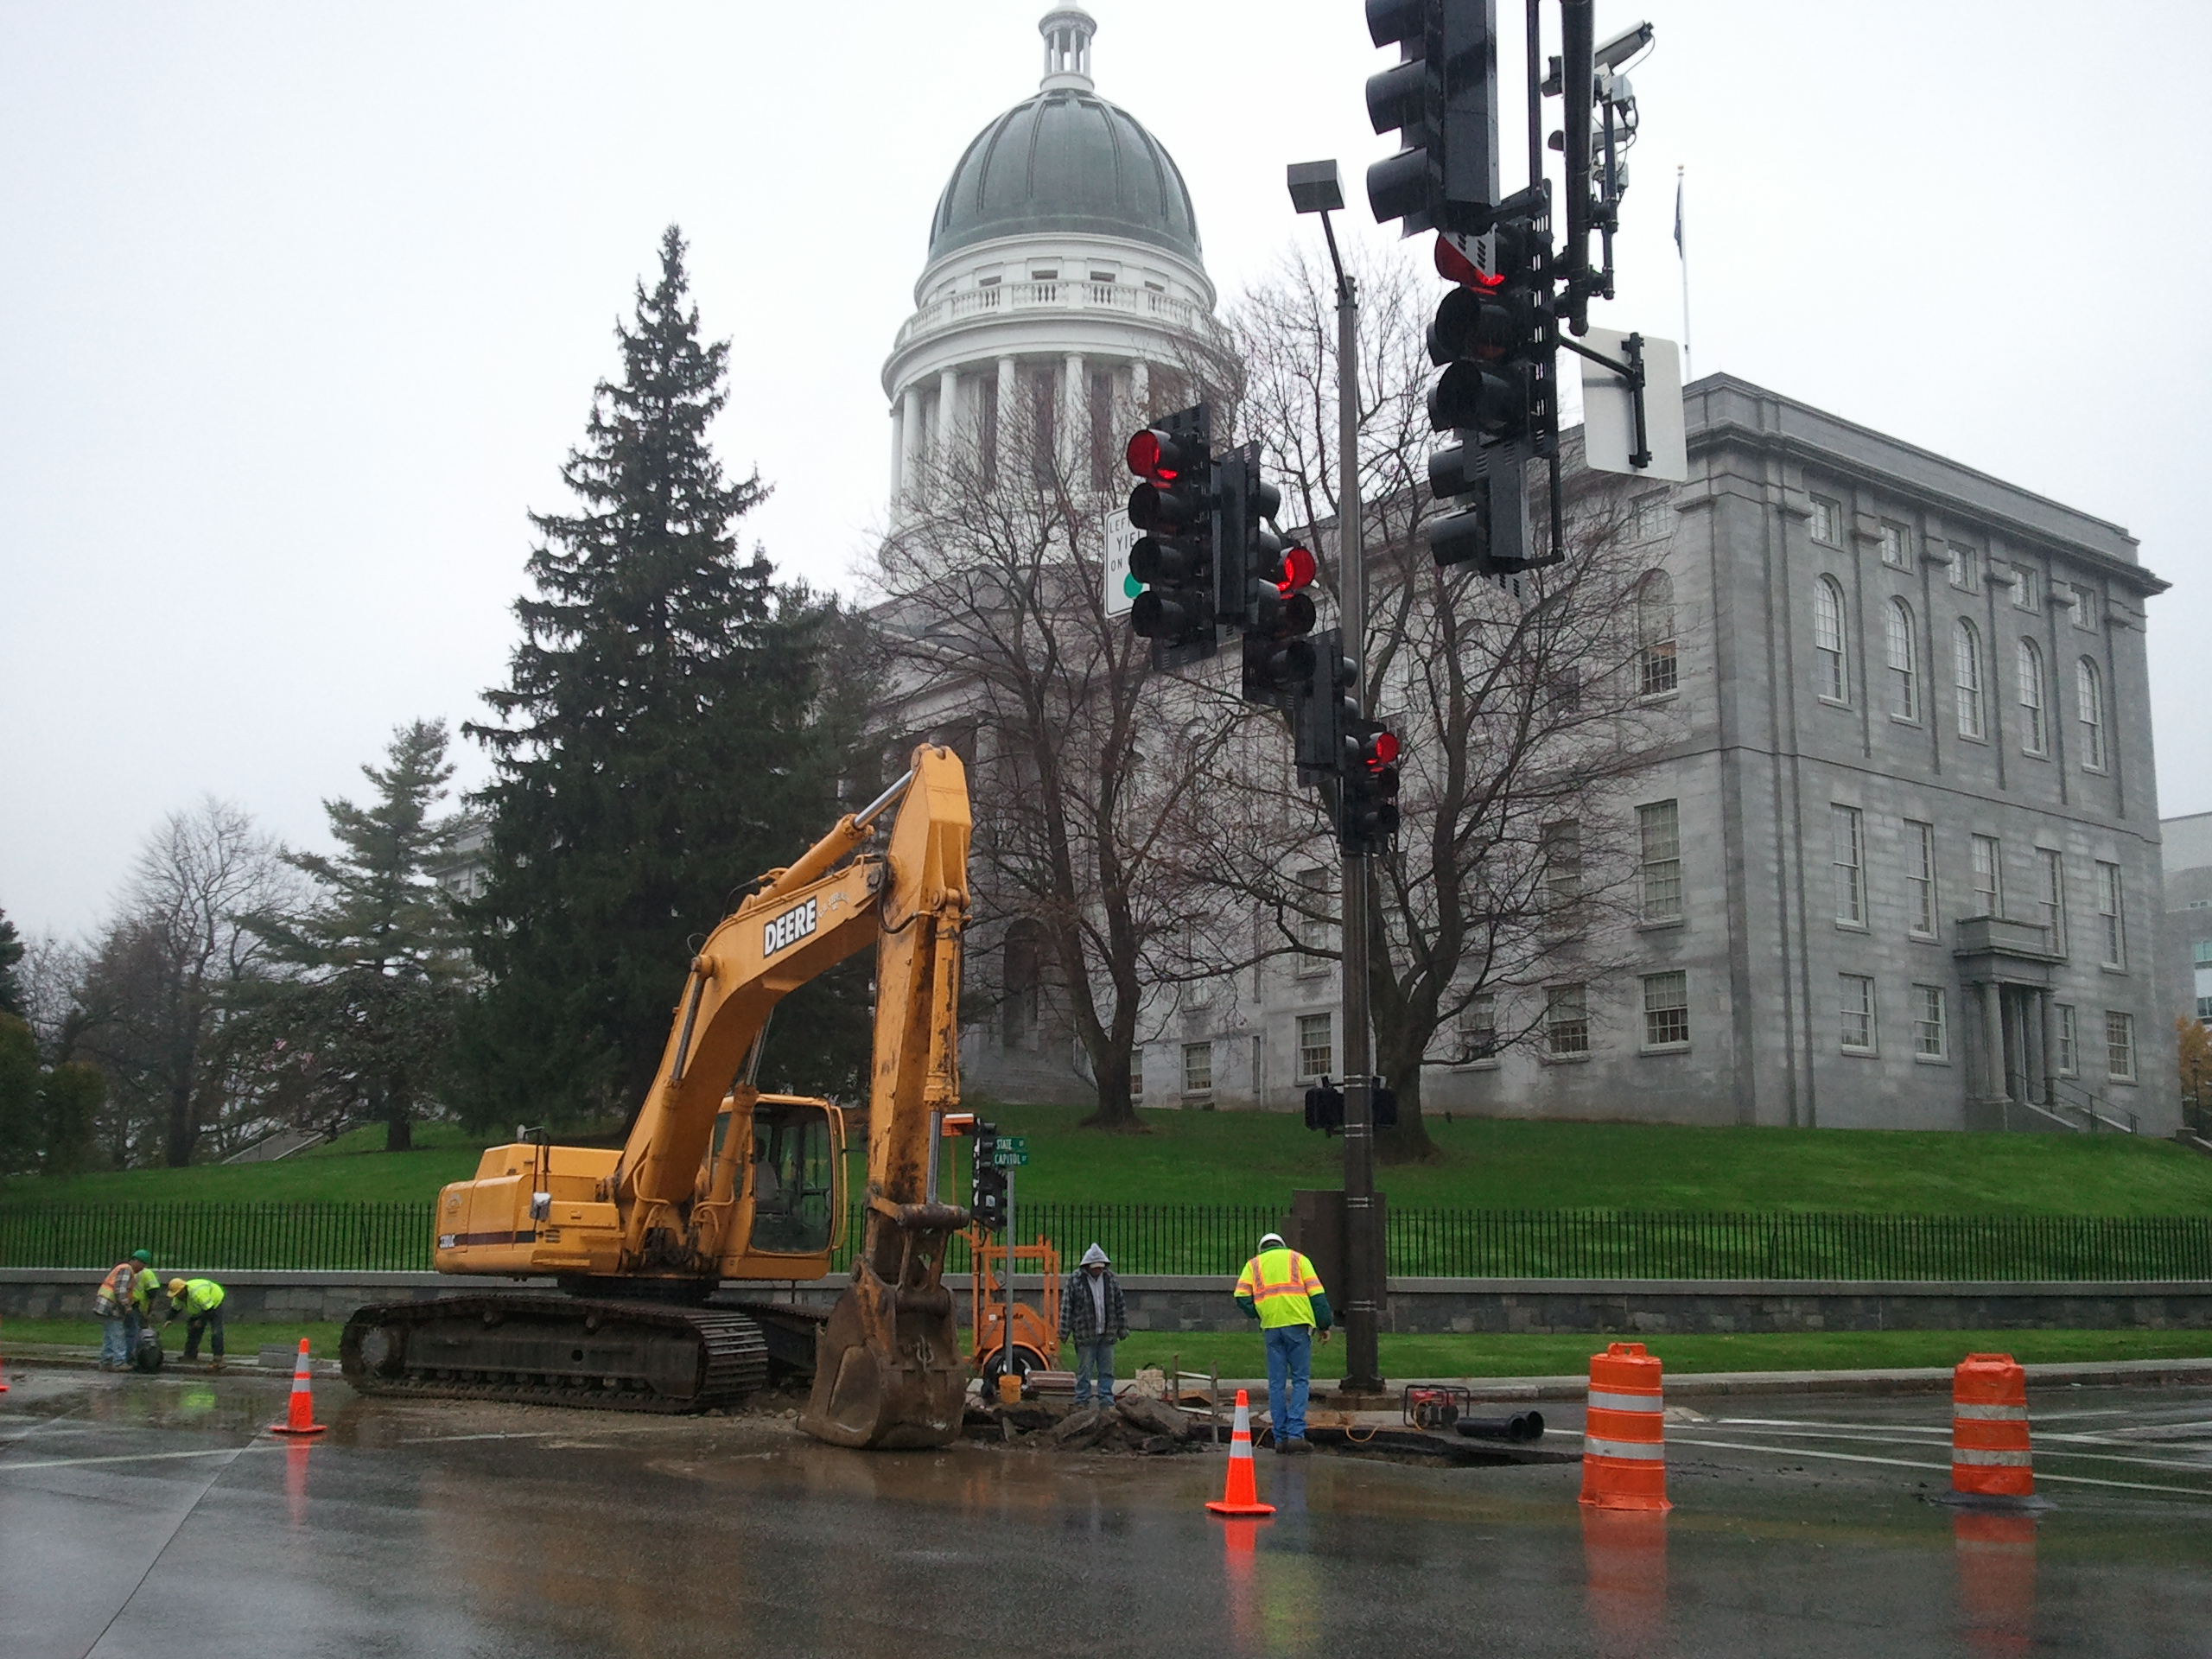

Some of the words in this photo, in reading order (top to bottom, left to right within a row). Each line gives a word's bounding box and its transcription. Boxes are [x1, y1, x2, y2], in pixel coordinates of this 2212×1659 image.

[1111, 557, 1122, 572] ON
[764, 898, 817, 956] DEERE
[996, 1138, 1012, 1150] STATE
[994, 1153, 1021, 1165] CAPITOL
